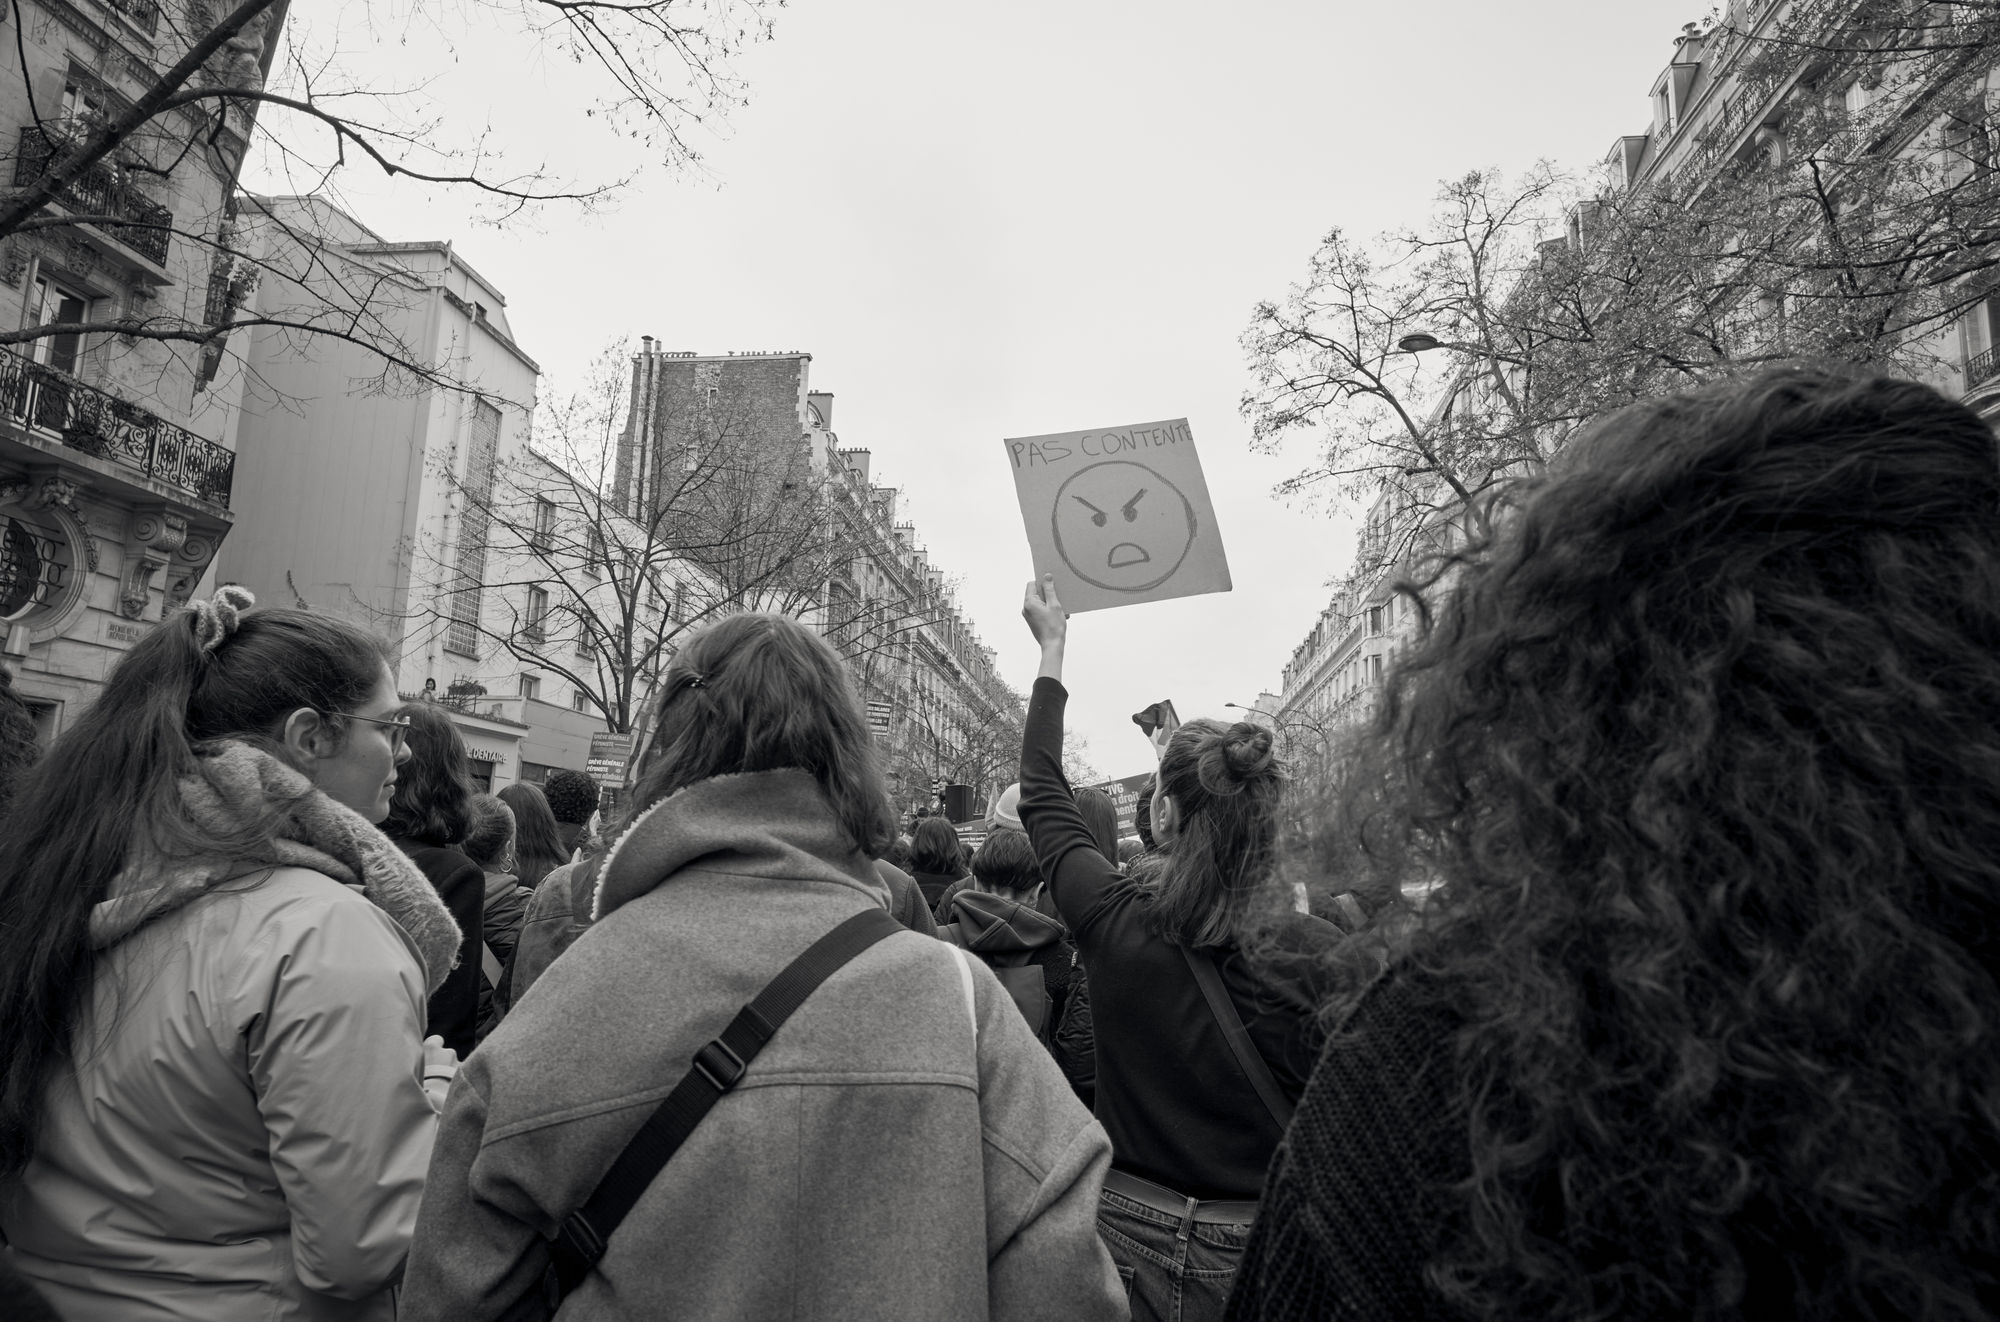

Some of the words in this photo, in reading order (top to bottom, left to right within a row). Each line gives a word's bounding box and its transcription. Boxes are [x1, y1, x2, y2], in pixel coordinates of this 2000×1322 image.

[1011, 440, 1073, 468] PAS
[1081, 423, 1193, 456] CONTENTE
[1118, 791, 1140, 804] droit
